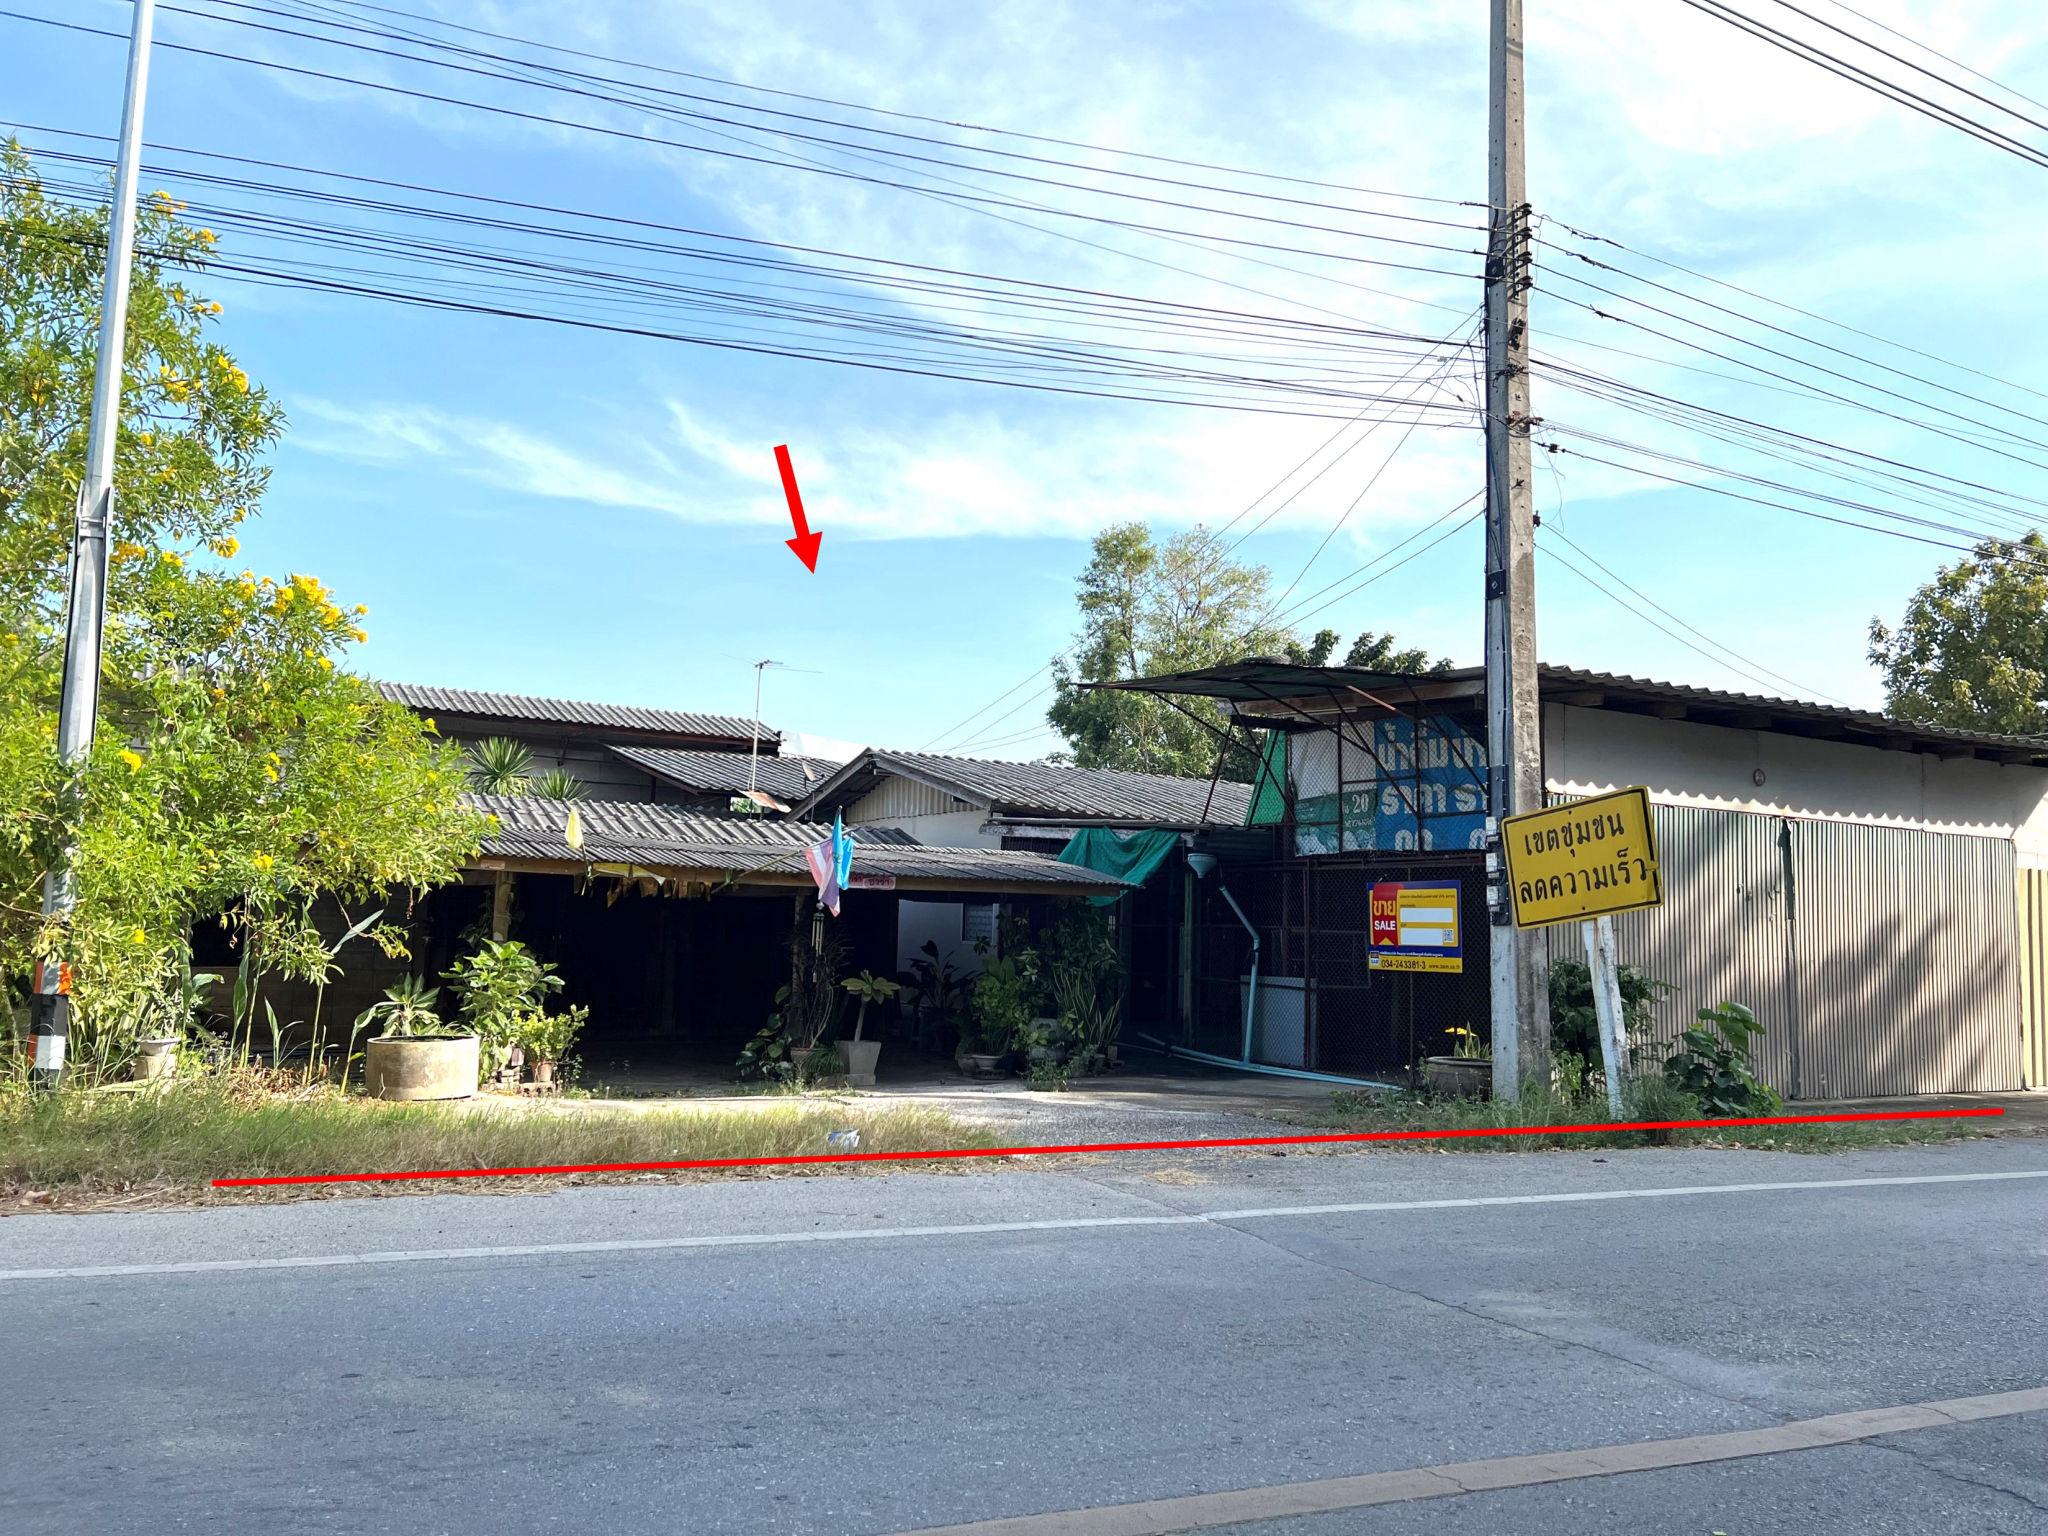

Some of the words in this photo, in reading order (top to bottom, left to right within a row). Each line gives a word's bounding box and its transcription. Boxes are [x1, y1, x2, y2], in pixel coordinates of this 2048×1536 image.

[1352, 793, 1369, 814] 20
[1525, 812, 1625, 858] เขตชุมชน
[1519, 847, 1647, 904] ลดความเร็ว
[1373, 900, 1396, 916] ขาย
[1374, 920, 1396, 931] SALE
[1381, 959, 1426, 970] 034-243381-3
